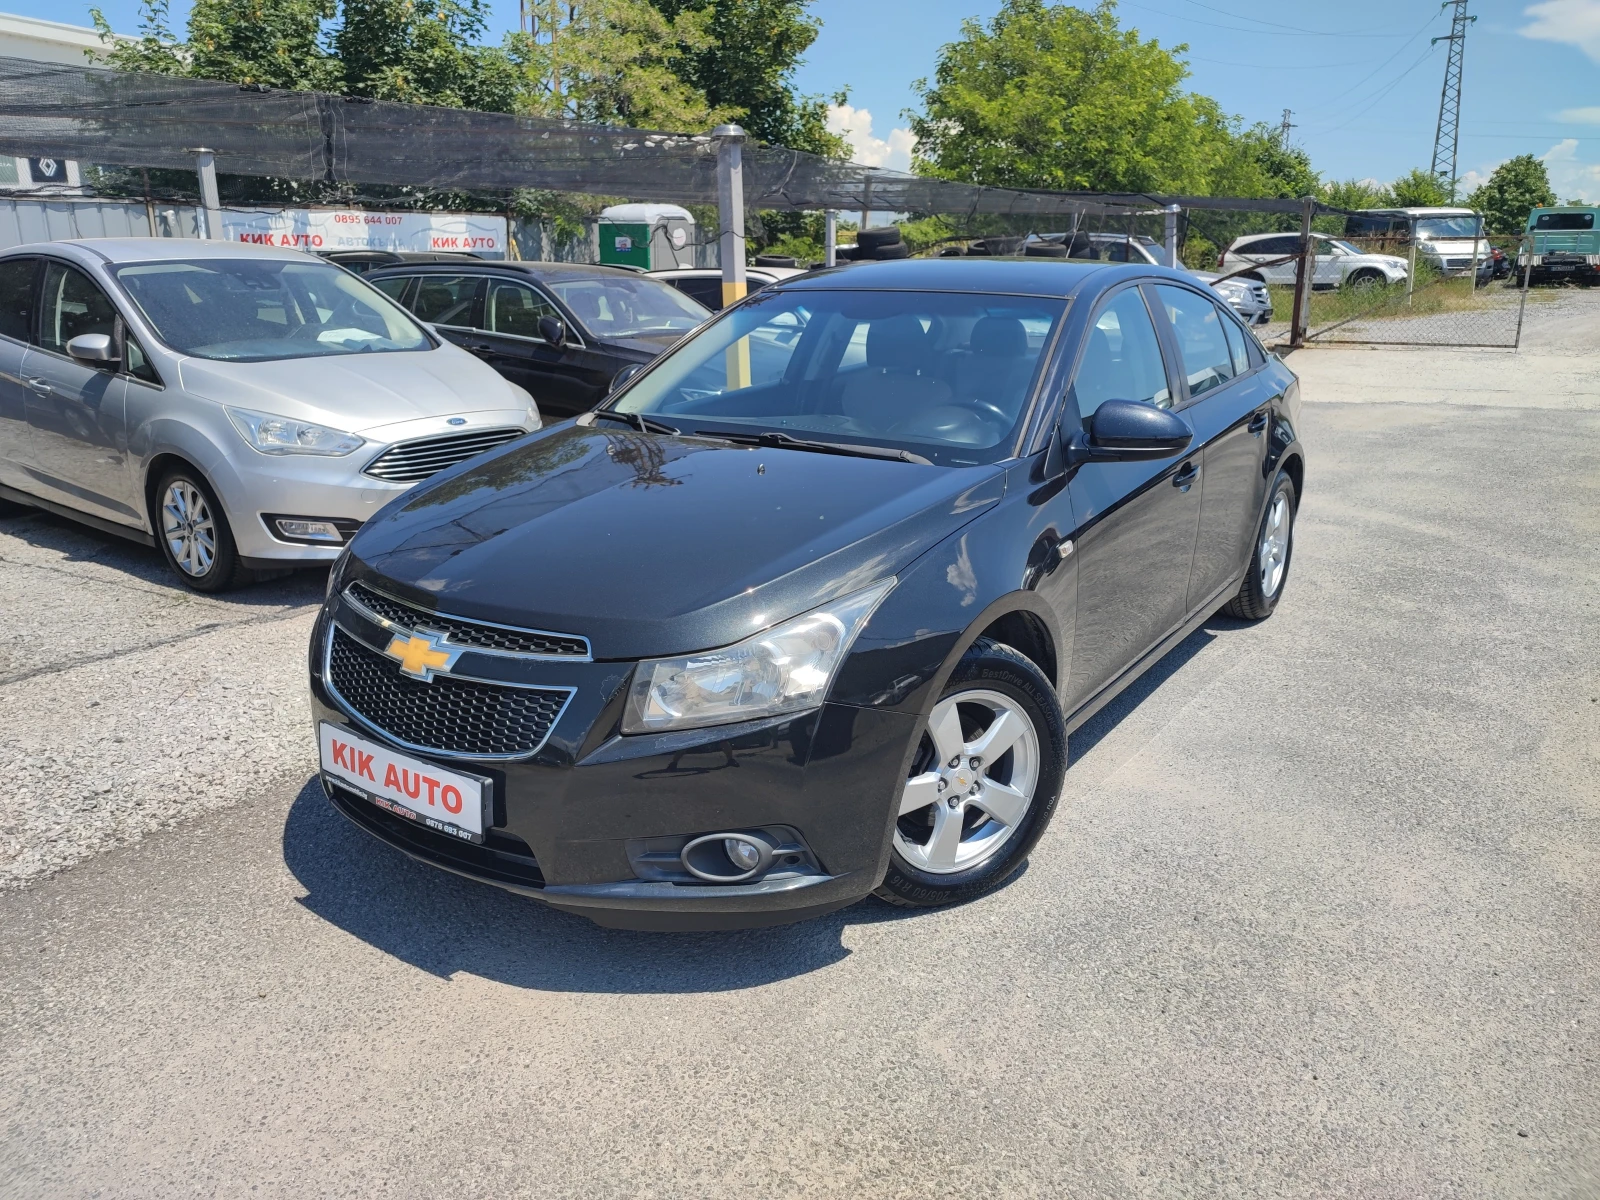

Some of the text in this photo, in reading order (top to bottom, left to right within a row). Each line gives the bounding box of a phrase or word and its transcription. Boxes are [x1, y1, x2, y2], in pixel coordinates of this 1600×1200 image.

[334, 214, 403, 225] 0895 644 007
[240, 233, 323, 247] КИК АУТО
[432, 237, 495, 249] КИК АУТО
[981, 668, 1023, 686] BestDrive
[1021, 682, 1035, 697] ALL
[1033, 691, 1058, 731] SEASONS
[332, 738, 376, 783] KIK
[384, 762, 463, 815] AUTO
[375, 796, 417, 820] KIK AUTO
[458, 830, 473, 841] 007
[912, 888, 951, 901] 205/60
